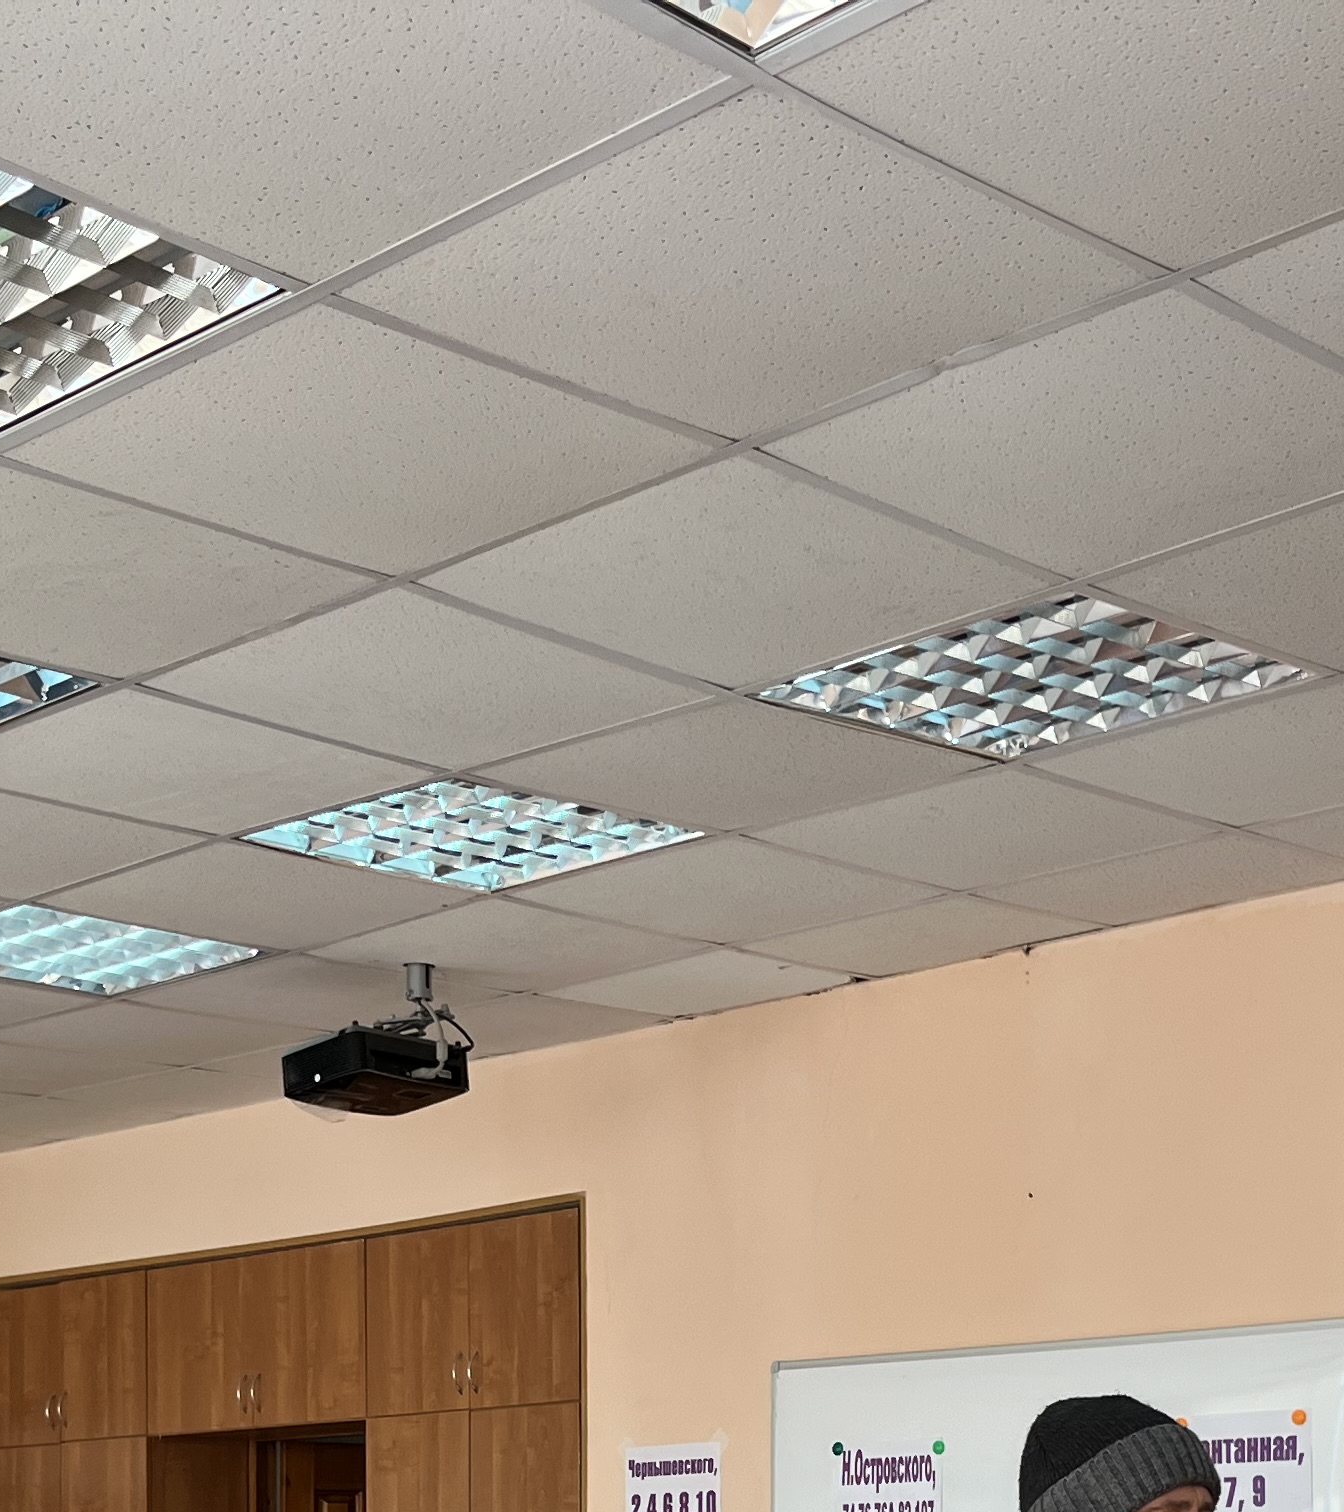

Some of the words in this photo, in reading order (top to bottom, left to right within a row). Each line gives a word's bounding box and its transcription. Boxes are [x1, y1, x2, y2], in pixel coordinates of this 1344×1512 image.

[1201, 1435, 1305, 1466] нтанная,
[628, 1457, 717, 1480] Чернышевского,
[841, 1449, 936, 1493] Н.Островского,
